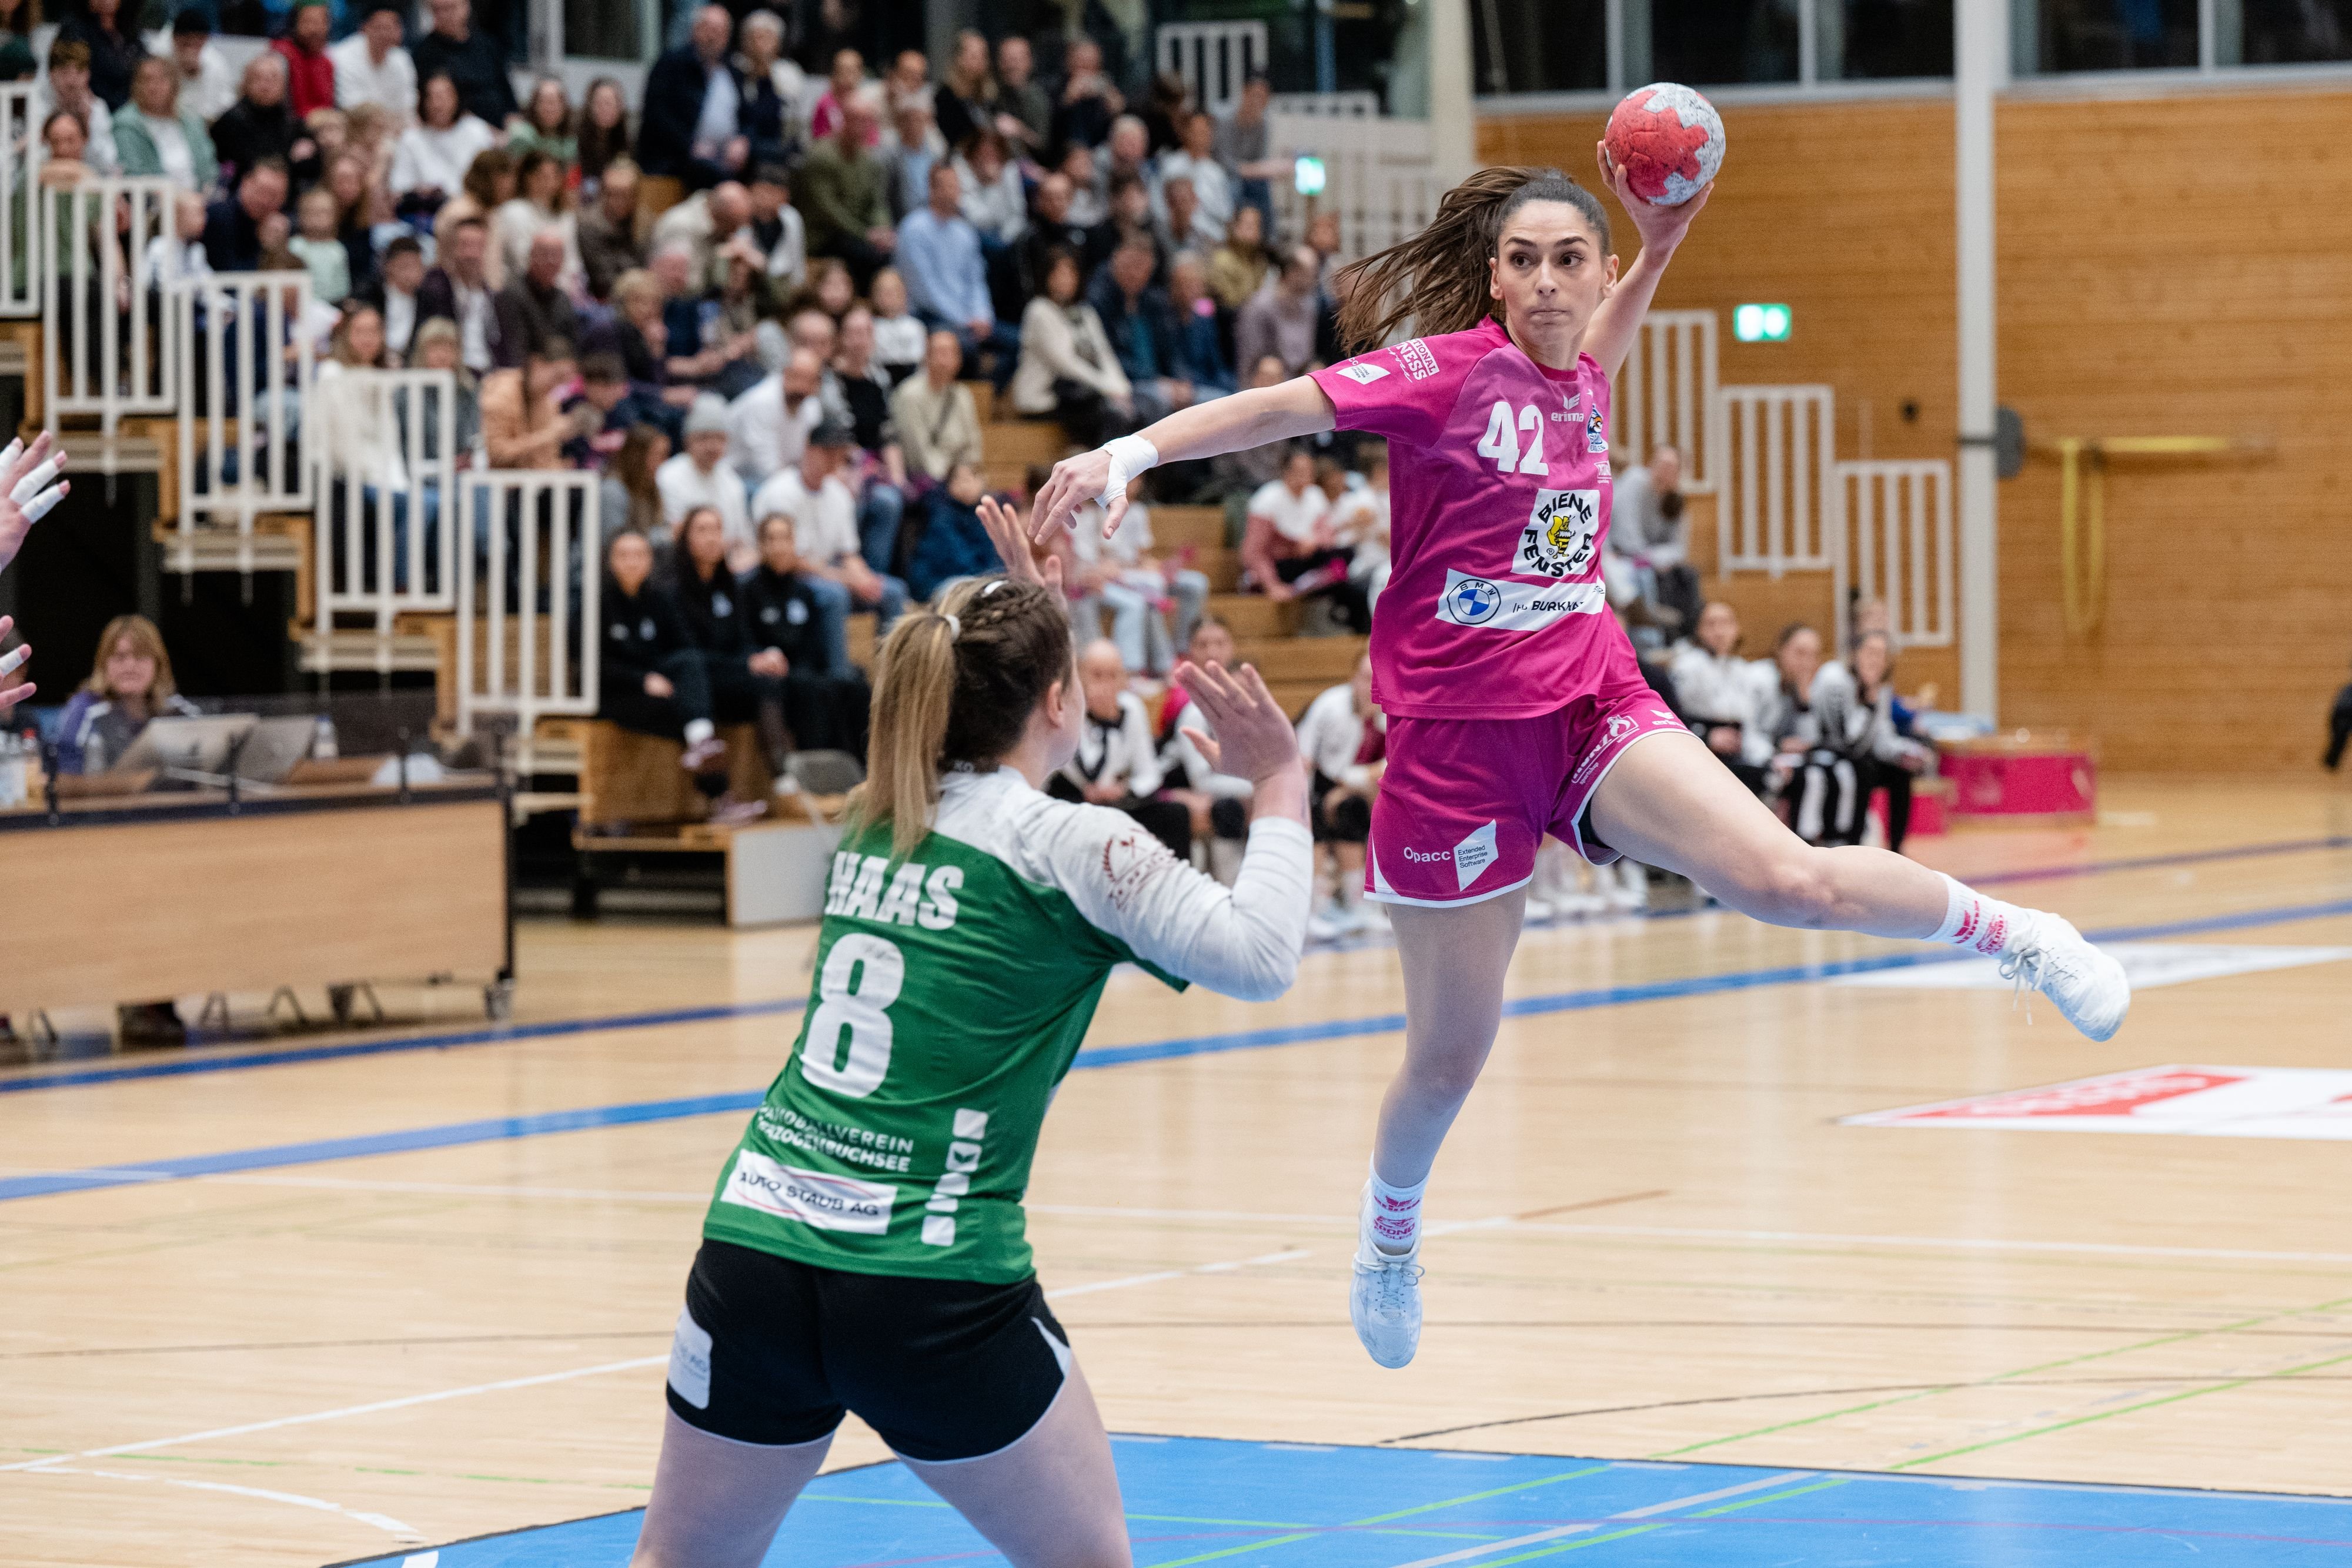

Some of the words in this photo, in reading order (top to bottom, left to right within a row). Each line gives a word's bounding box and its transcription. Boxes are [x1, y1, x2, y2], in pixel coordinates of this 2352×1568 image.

[1395, 342, 1428, 380] NESS
[1413, 339, 1436, 374] TIONAL
[1551, 412, 1584, 422] erima
[1477, 402, 1549, 476] 42
[1537, 493, 1592, 524] BIENE
[1531, 600, 1584, 611] BURKHA
[1404, 847, 1451, 864] Opacc
[1458, 845, 1486, 855] Extended
[1459, 851, 1488, 862] Enterprise
[1459, 858, 1485, 868] Software
[824, 850, 965, 931] HAAS
[799, 932, 905, 1099] 8
[740, 1172, 781, 1191] AUTO
[787, 1185, 844, 1211] STAUB
[850, 1203, 878, 1216] AG
